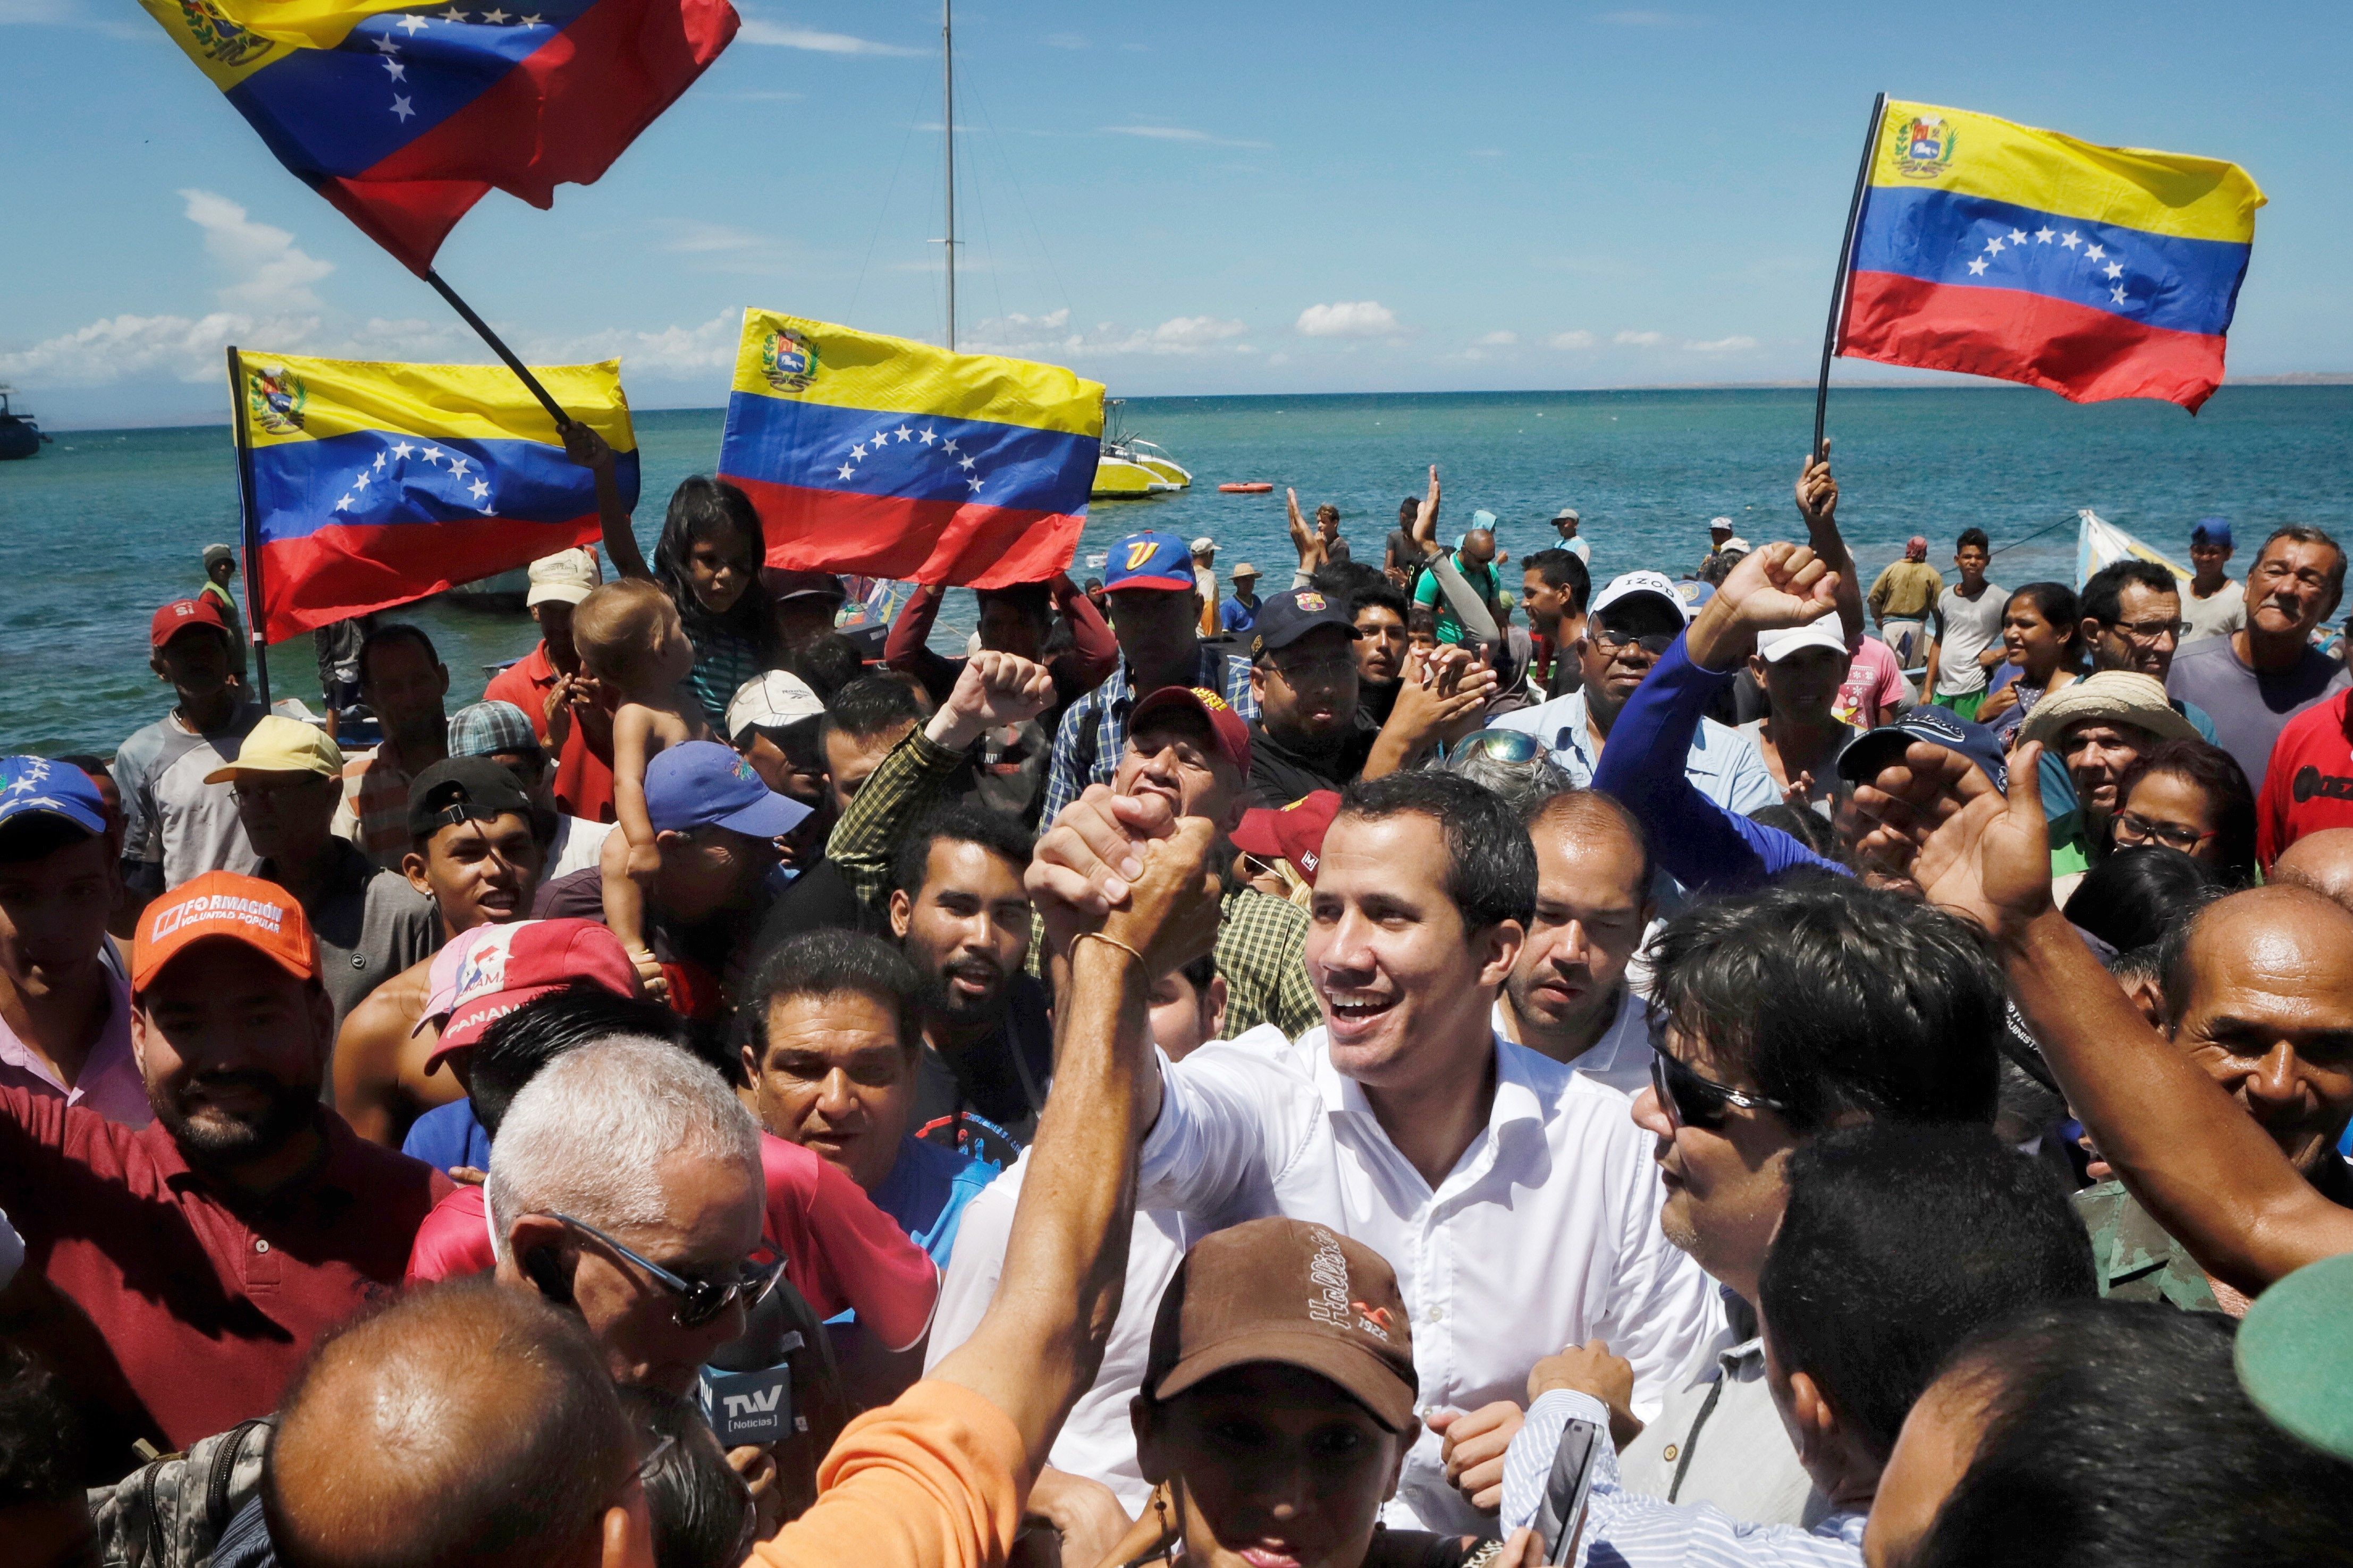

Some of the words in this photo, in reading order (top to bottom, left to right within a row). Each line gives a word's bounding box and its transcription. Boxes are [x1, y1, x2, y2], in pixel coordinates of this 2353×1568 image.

[1125, 542, 1159, 571] V
[1626, 578, 1674, 598] IZOD
[184, 895, 283, 922] FORMACIÓN
[181, 910, 236, 927] VOLUNTAD
[237, 912, 281, 934] POPULAR
[446, 1003, 521, 1040] PANAM
[1358, 1317, 1388, 1342] 1922
